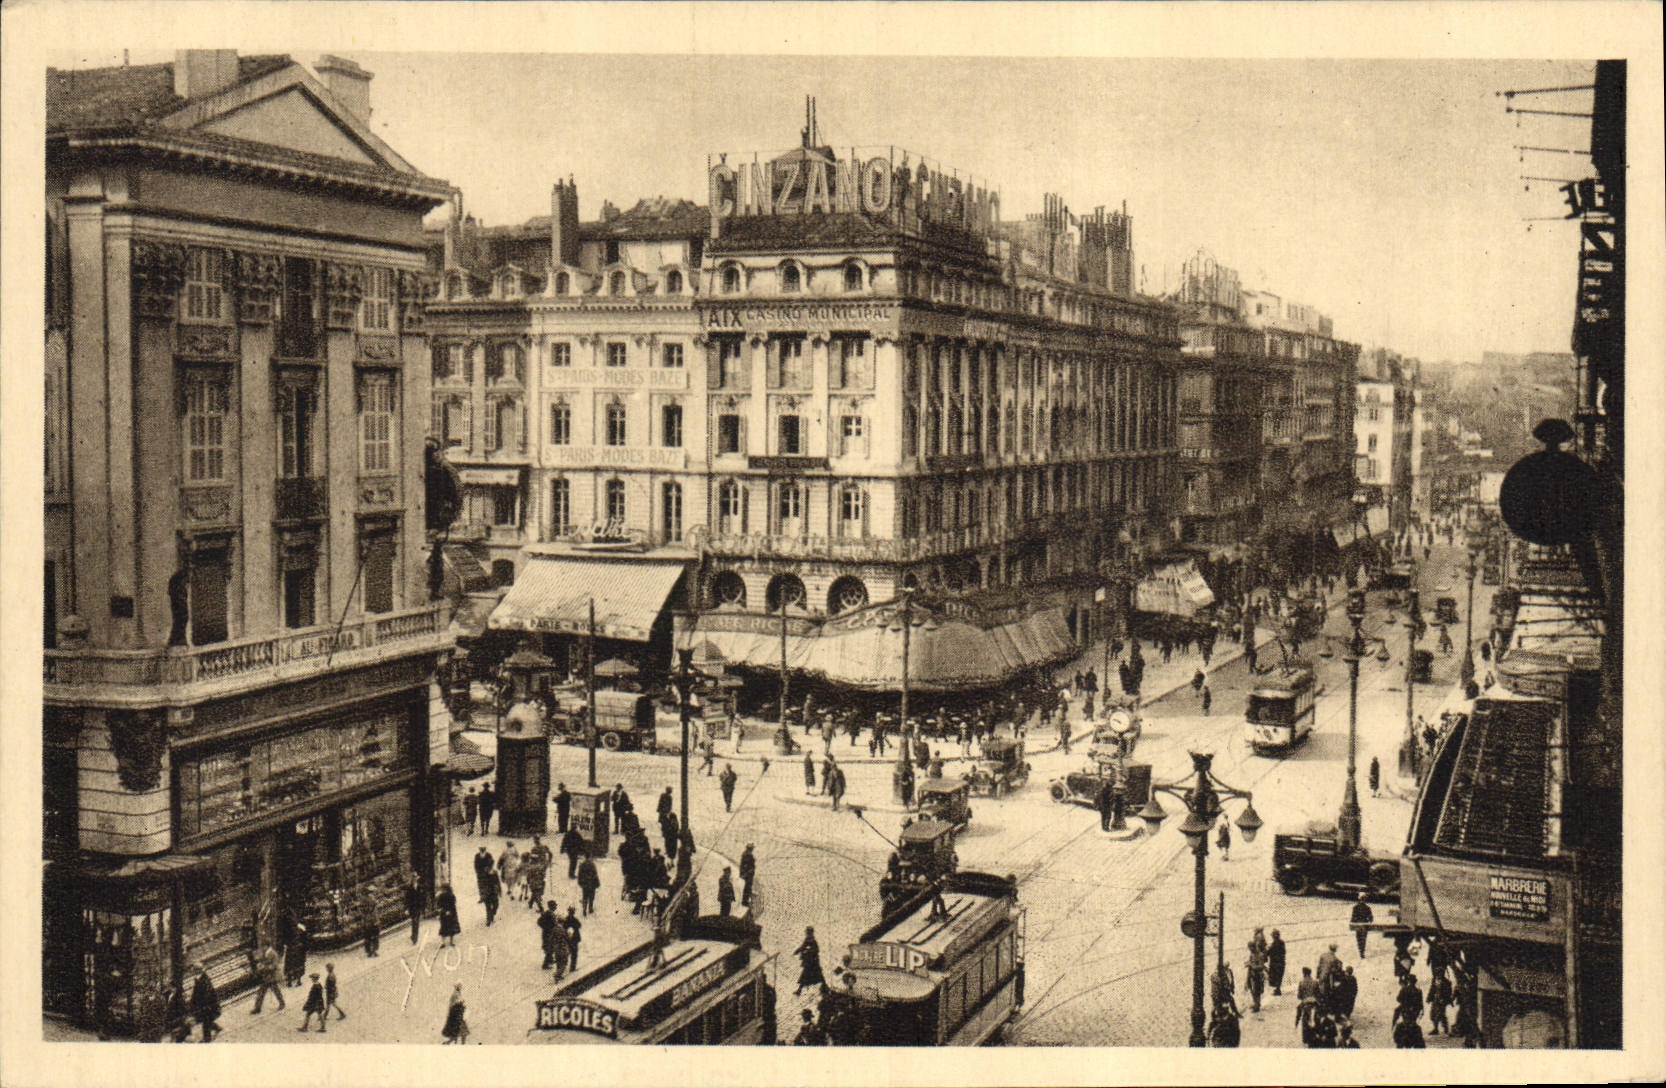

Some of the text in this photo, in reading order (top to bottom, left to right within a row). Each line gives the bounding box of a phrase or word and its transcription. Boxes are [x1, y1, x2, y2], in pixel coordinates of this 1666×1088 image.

[708, 156, 891, 217] CINZANO
[708, 308, 743, 328] AIX
[746, 308, 801, 321] CASINO
[808, 307, 891, 321] MUNICIPAL
[1491, 876, 1547, 896] MARBRERIE
[886, 945, 924, 971] LIP
